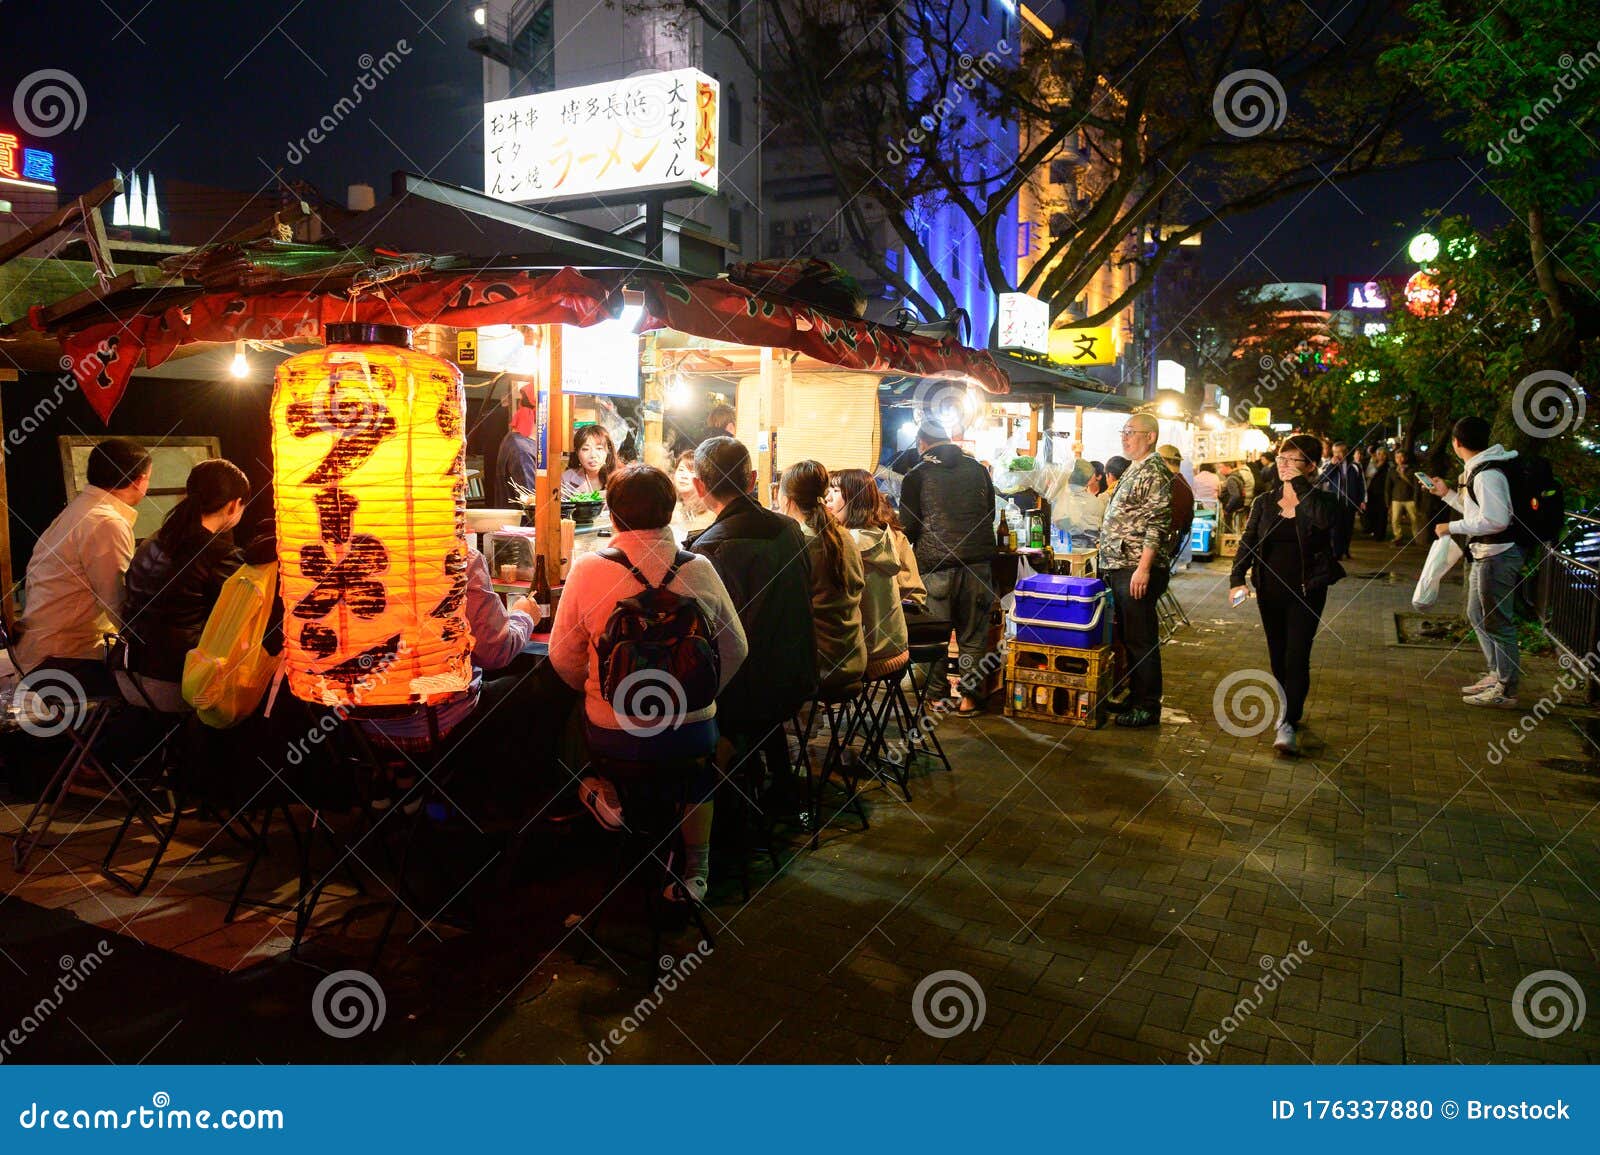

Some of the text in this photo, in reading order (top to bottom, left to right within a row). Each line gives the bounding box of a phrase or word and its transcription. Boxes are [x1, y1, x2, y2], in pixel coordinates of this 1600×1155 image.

[560, 89, 647, 125] 博多長浜
[665, 78, 688, 178] 大ちゃん
[699, 83, 715, 178] ラーメン
[490, 114, 506, 196] おでん
[508, 112, 525, 192] 牛タン
[550, 127, 661, 189] ラーメン
[286, 362, 402, 685] ラーメン
